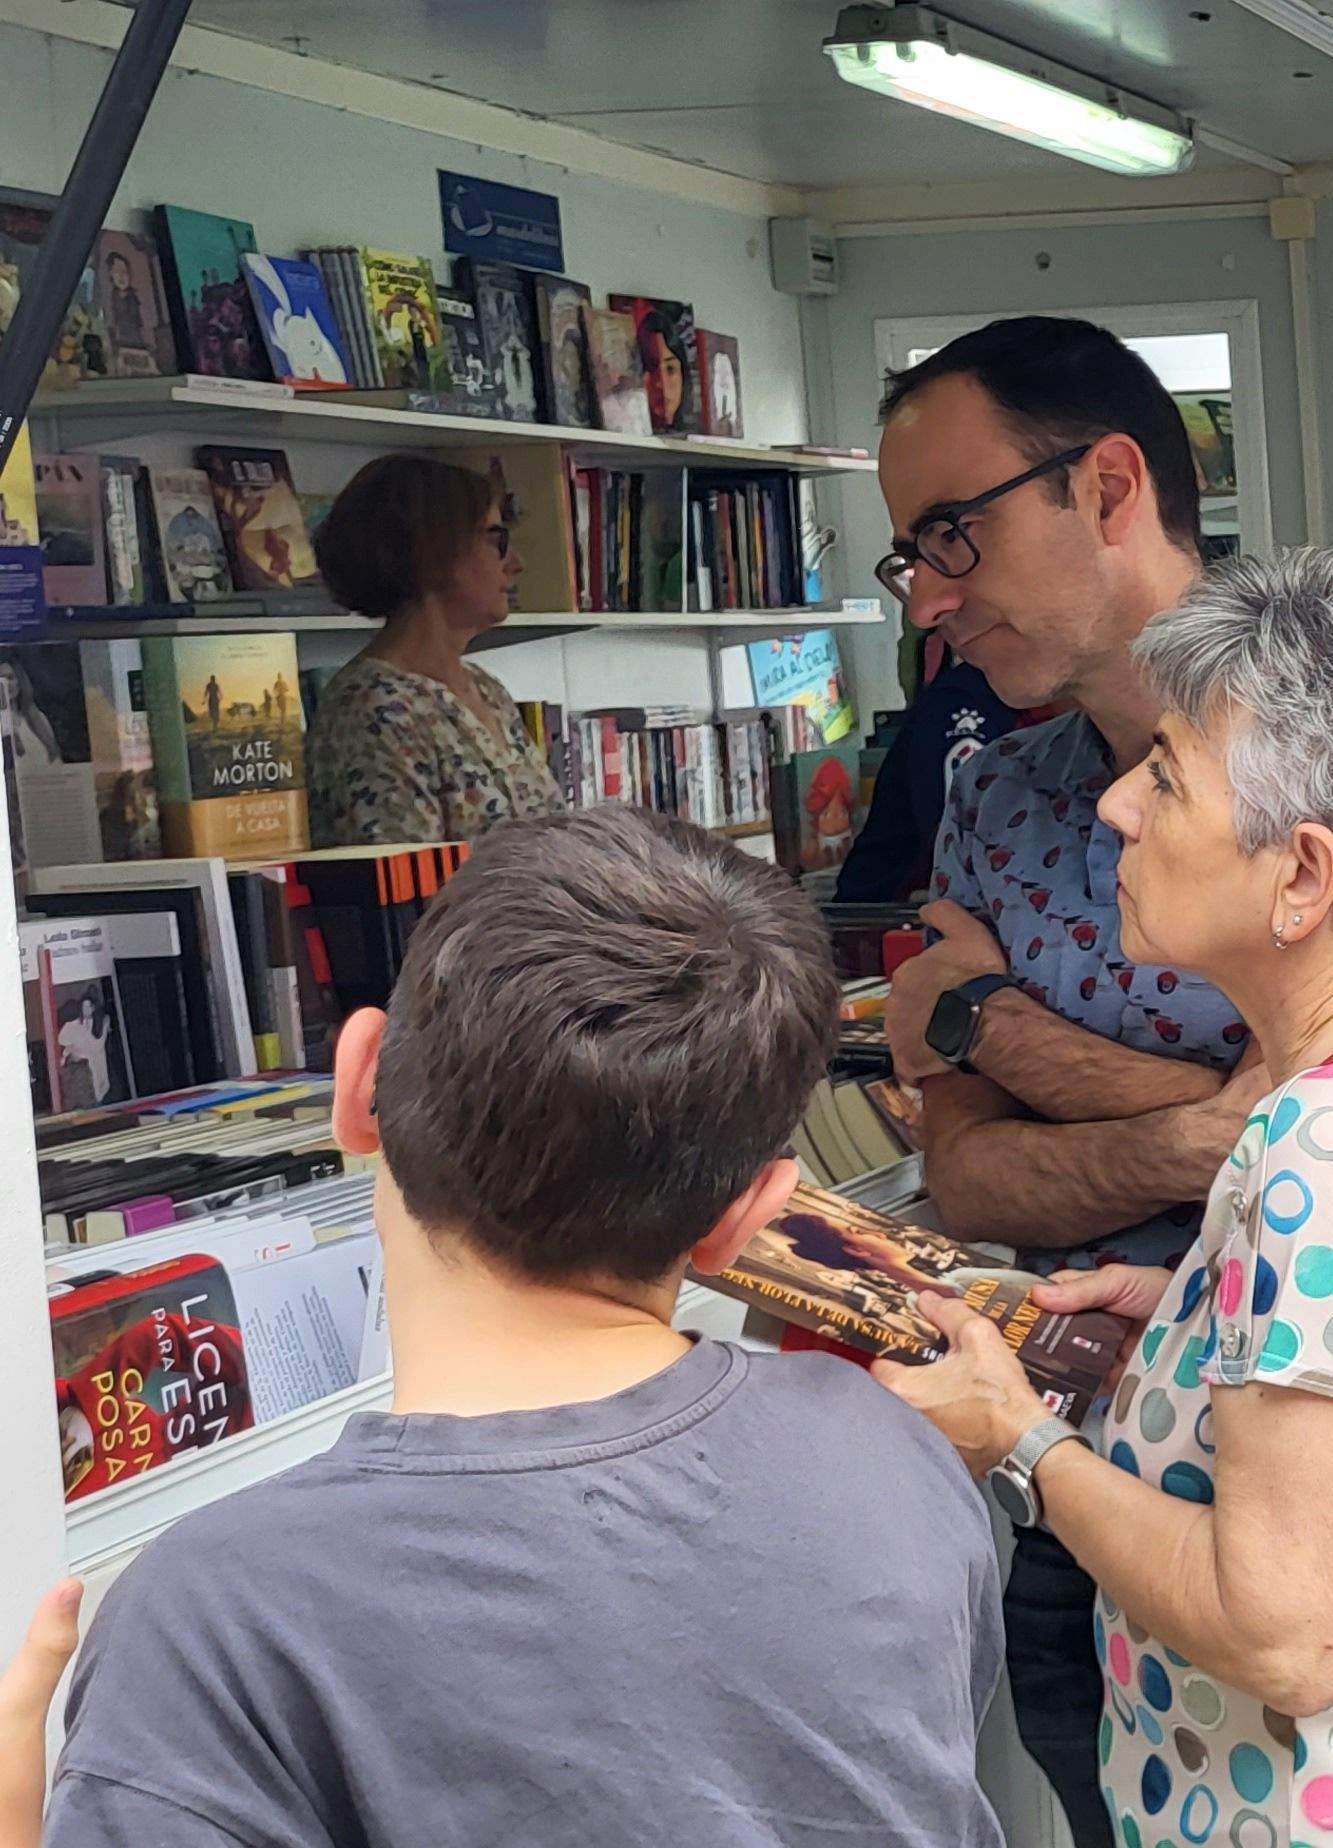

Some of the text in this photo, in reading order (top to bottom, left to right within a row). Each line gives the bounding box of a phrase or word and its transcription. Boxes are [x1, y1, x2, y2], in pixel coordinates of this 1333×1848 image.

[232, 740, 273, 761] KATE
[212, 759, 294, 787] MORTON
[760, 1282, 801, 1309] FLOR
[805, 1302, 828, 1319] LA
[827, 1308, 850, 1326] DE
[151, 1307, 178, 1373] PARA
[91, 1370, 127, 1482] POSA
